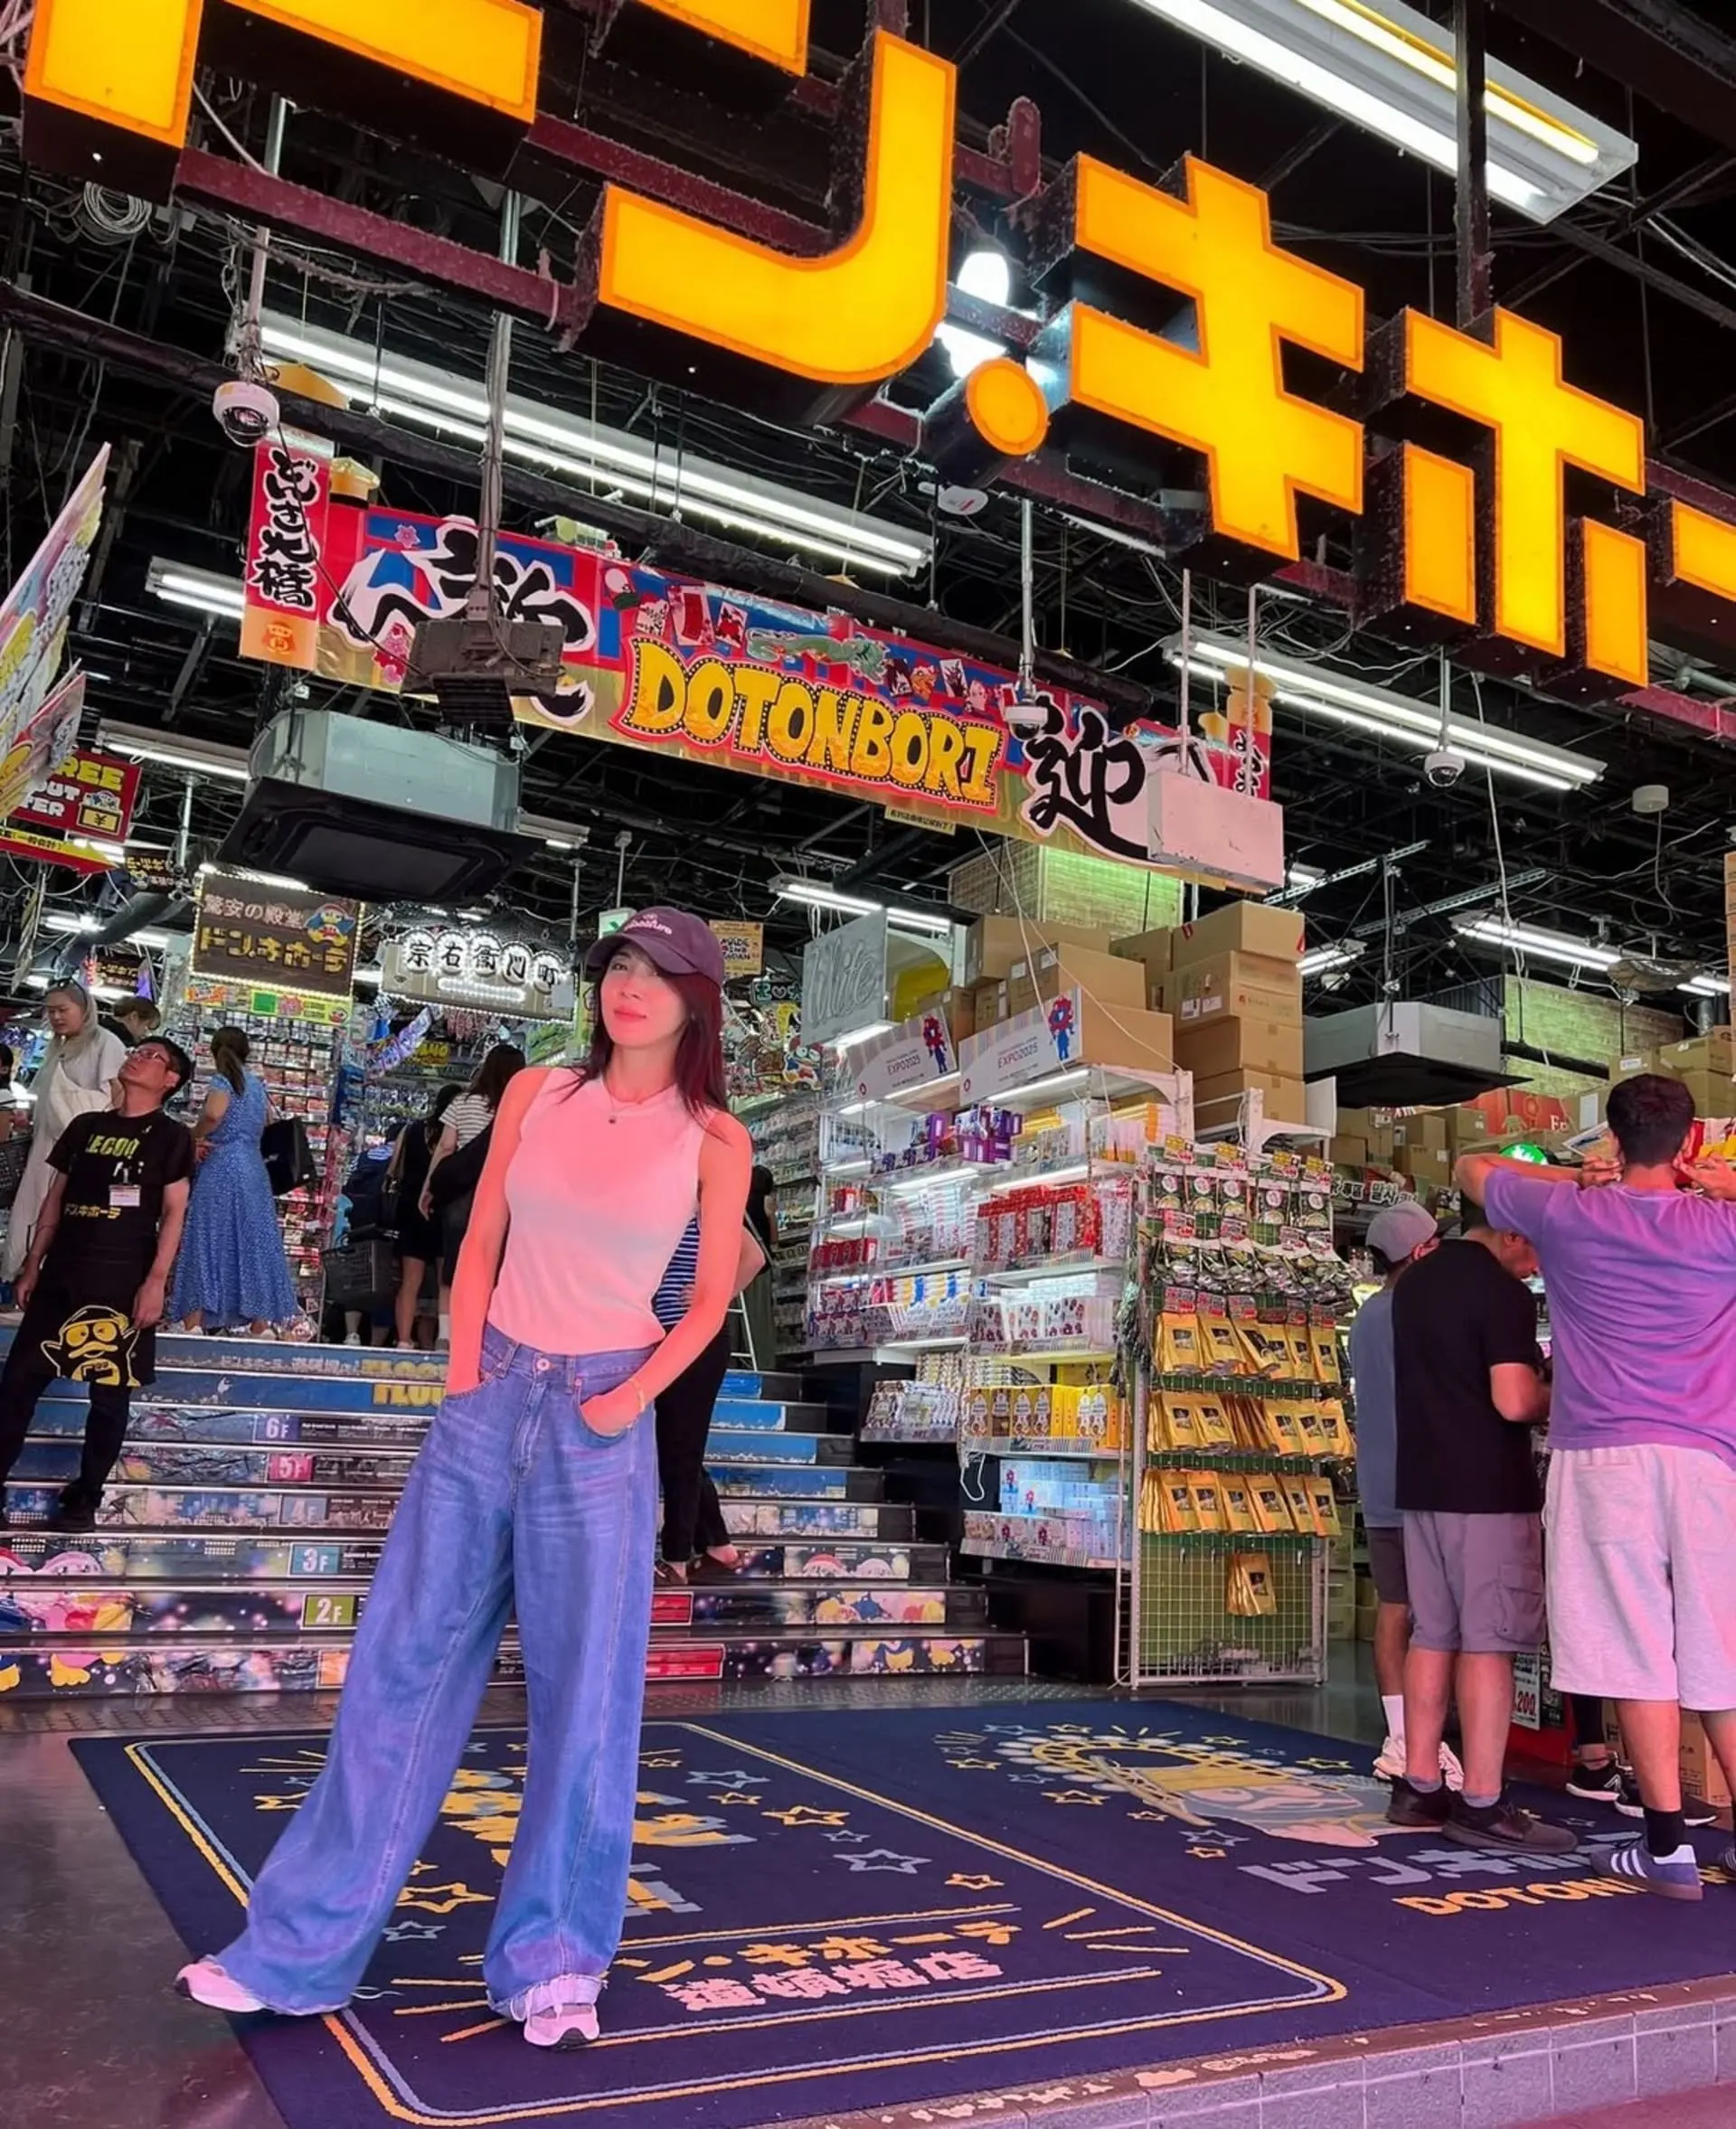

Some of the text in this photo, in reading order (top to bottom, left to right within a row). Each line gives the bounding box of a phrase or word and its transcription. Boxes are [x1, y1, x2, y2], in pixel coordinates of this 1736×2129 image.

[624, 636, 1005, 806] DOTONBORI
[56, 754, 125, 792] REE
[203, 893, 305, 929] 驚安の殿堂
[265, 1416, 290, 1439] 6F
[279, 1455, 305, 1479] 5F
[302, 1546, 330, 1574] 3F
[316, 1597, 344, 1625] 2F
[606, 1920, 1023, 1983] ン・キホーテ
[660, 1950, 1005, 2011] 道頓堀店
